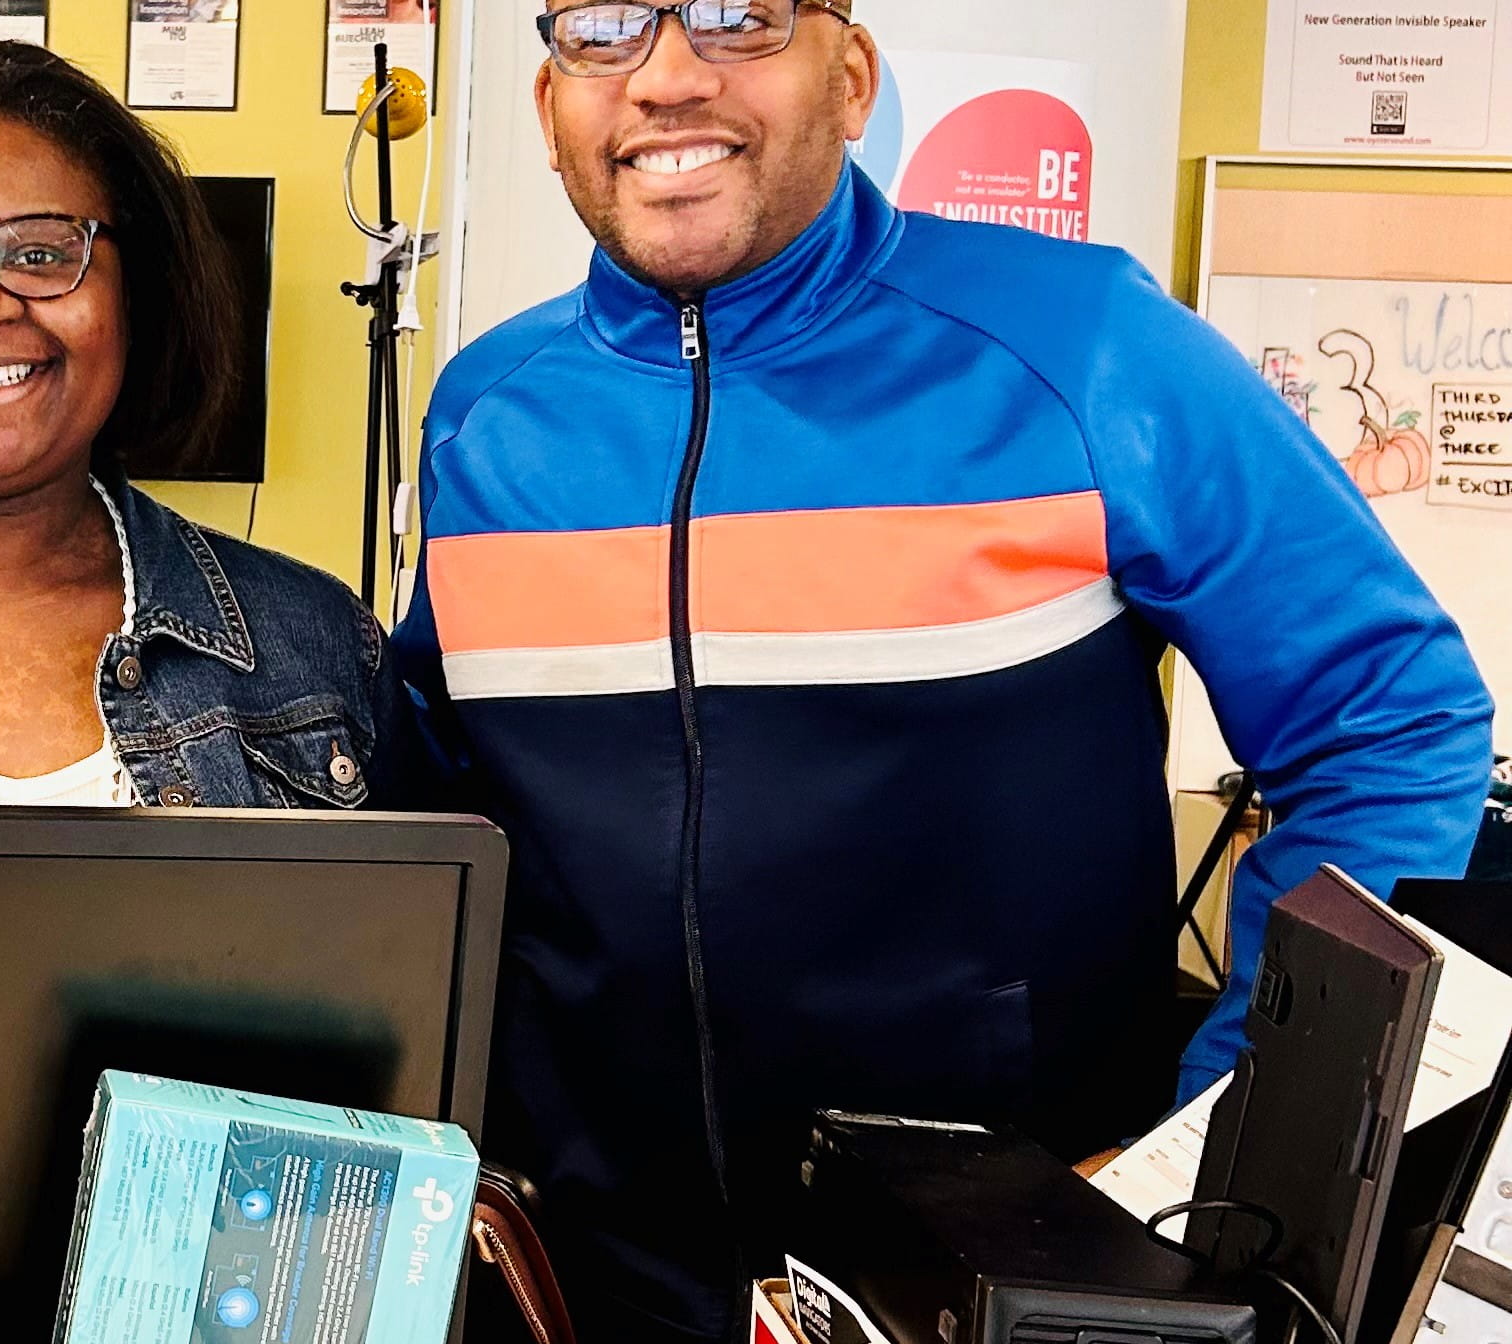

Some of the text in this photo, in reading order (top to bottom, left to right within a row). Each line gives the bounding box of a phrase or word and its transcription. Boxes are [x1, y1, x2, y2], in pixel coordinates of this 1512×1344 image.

[1304, 14, 1487, 29] New Generation Invisible Speaker
[360, 27, 385, 36] LEAH
[1338, 54, 1443, 67] Sound That Is Heard
[1356, 72, 1425, 83] But Not Seen
[1038, 148, 1081, 202] BE
[1439, 390, 1501, 404] THIRD
[1441, 410, 1512, 423] THURSDA
[1439, 425, 1456, 439] @
[1439, 442, 1502, 455] THREE
[310, 1158, 324, 1183] High
[308, 1182, 319, 1204] Gain
[373, 1207, 386, 1230] Dual
[406, 1223, 433, 1287] tp-link
